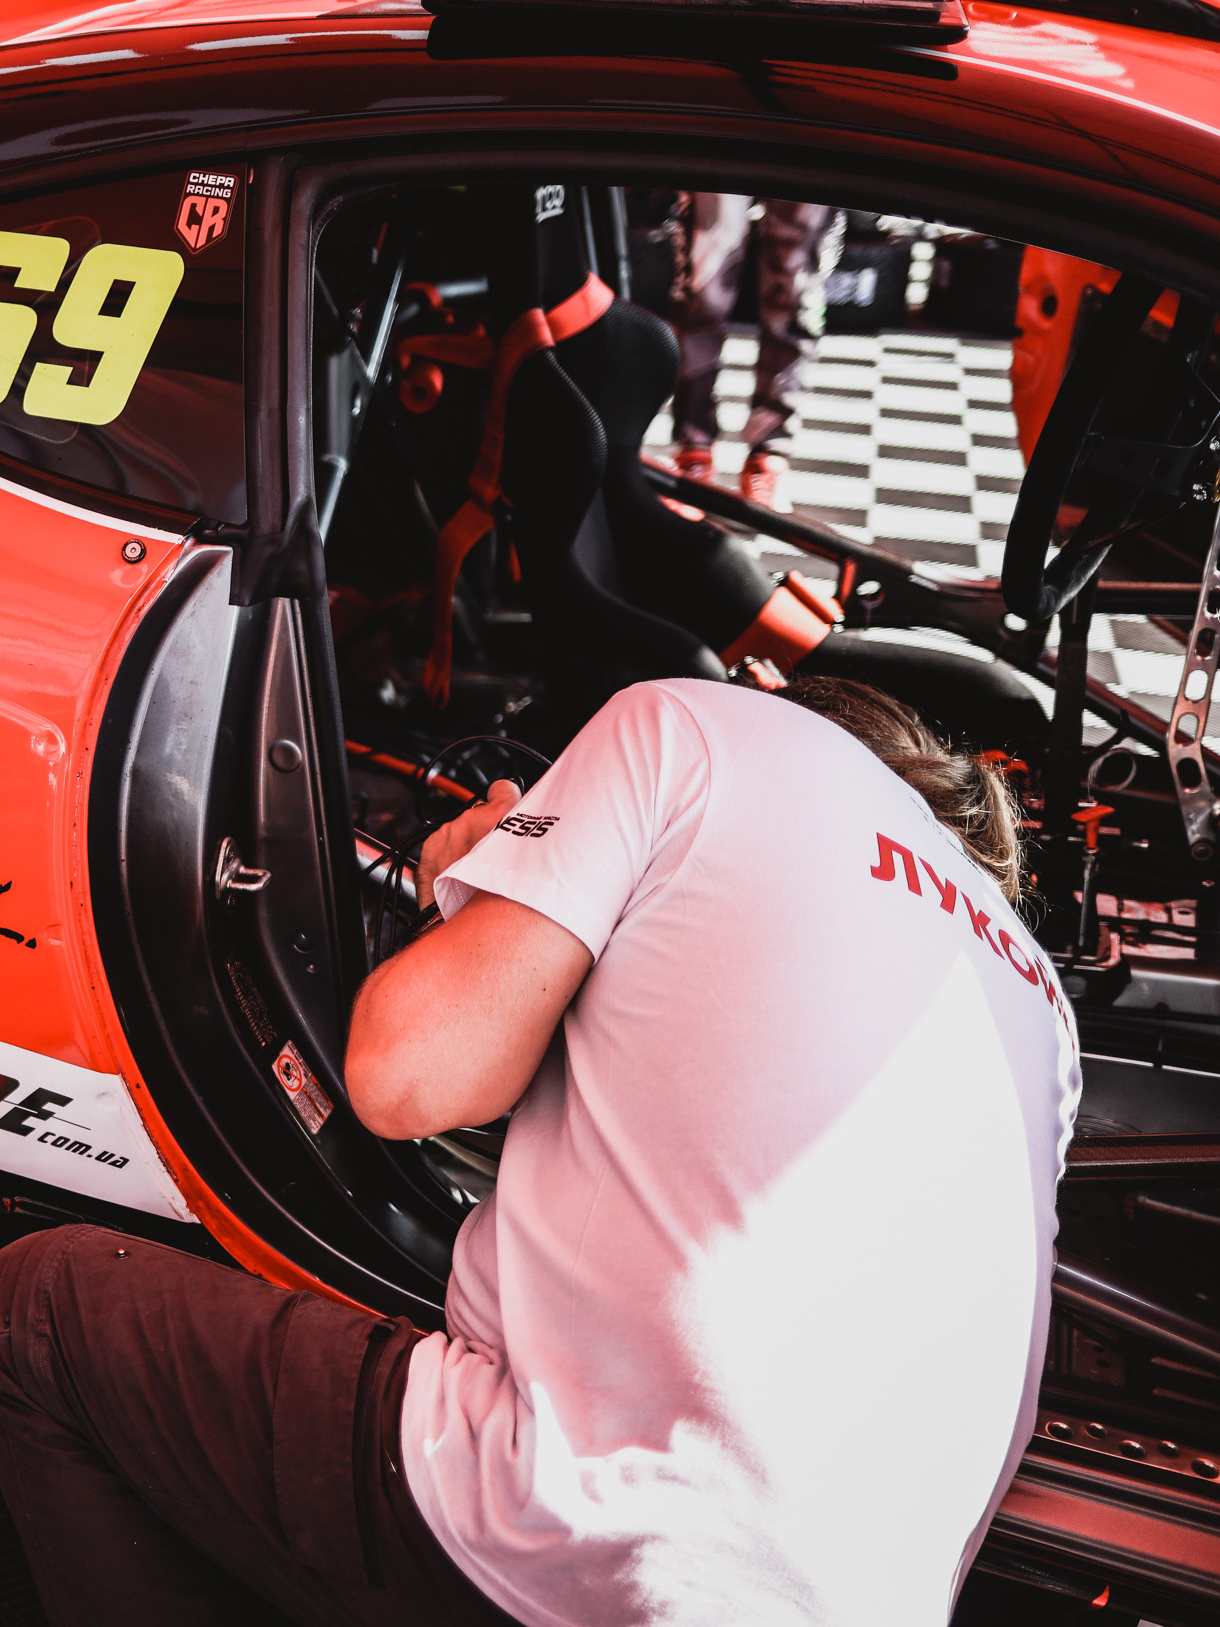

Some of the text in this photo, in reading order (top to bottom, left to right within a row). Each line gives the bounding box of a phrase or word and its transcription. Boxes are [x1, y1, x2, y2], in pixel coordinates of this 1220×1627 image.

[186, 184, 232, 198] RACING
[189, 172, 235, 188] CHEPA
[177, 195, 228, 249] CR
[37, 1130, 130, 1169] com.ua
